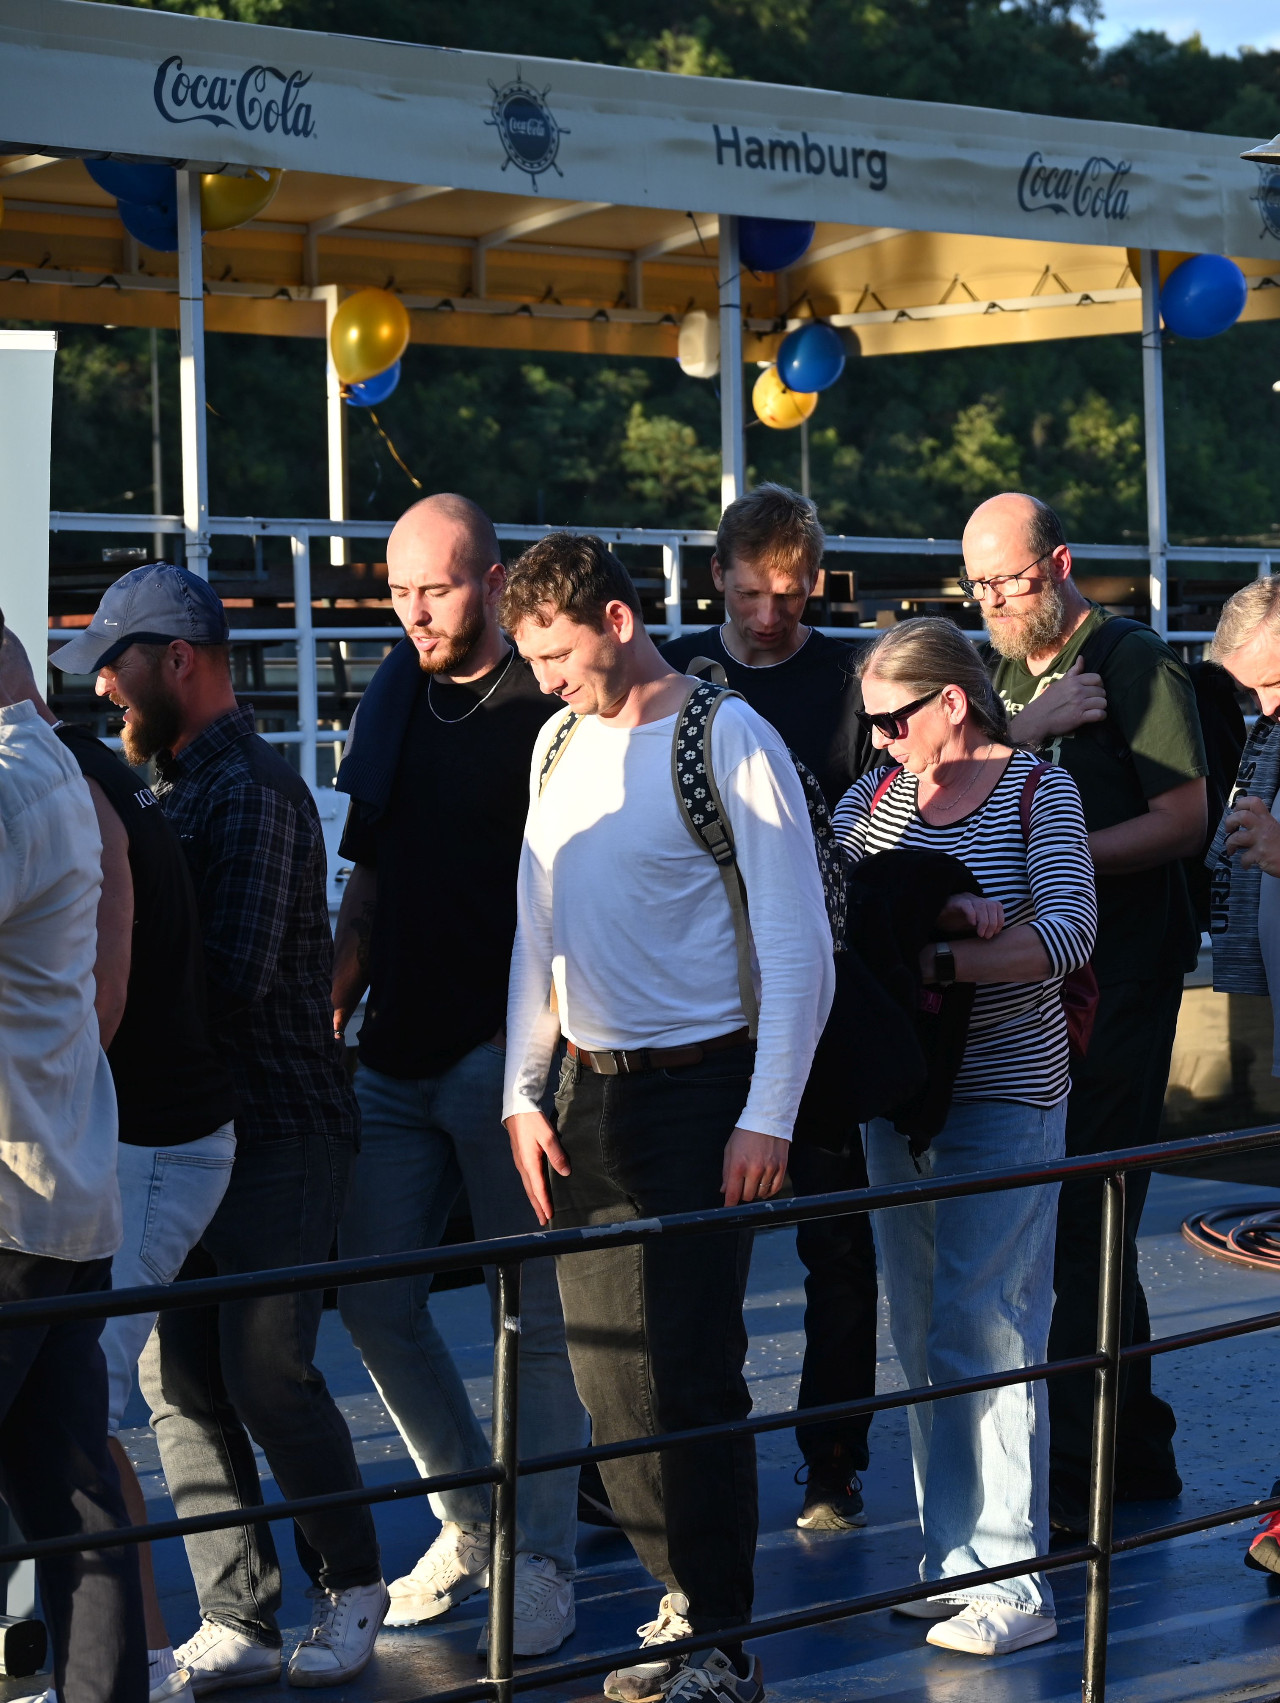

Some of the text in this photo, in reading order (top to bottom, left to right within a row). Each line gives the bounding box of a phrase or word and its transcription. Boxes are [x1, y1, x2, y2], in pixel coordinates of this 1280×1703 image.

[153, 55, 315, 139] Coca-Cola
[712, 123, 888, 192] Hamburg
[1017, 150, 1132, 220] Coca-Cola
